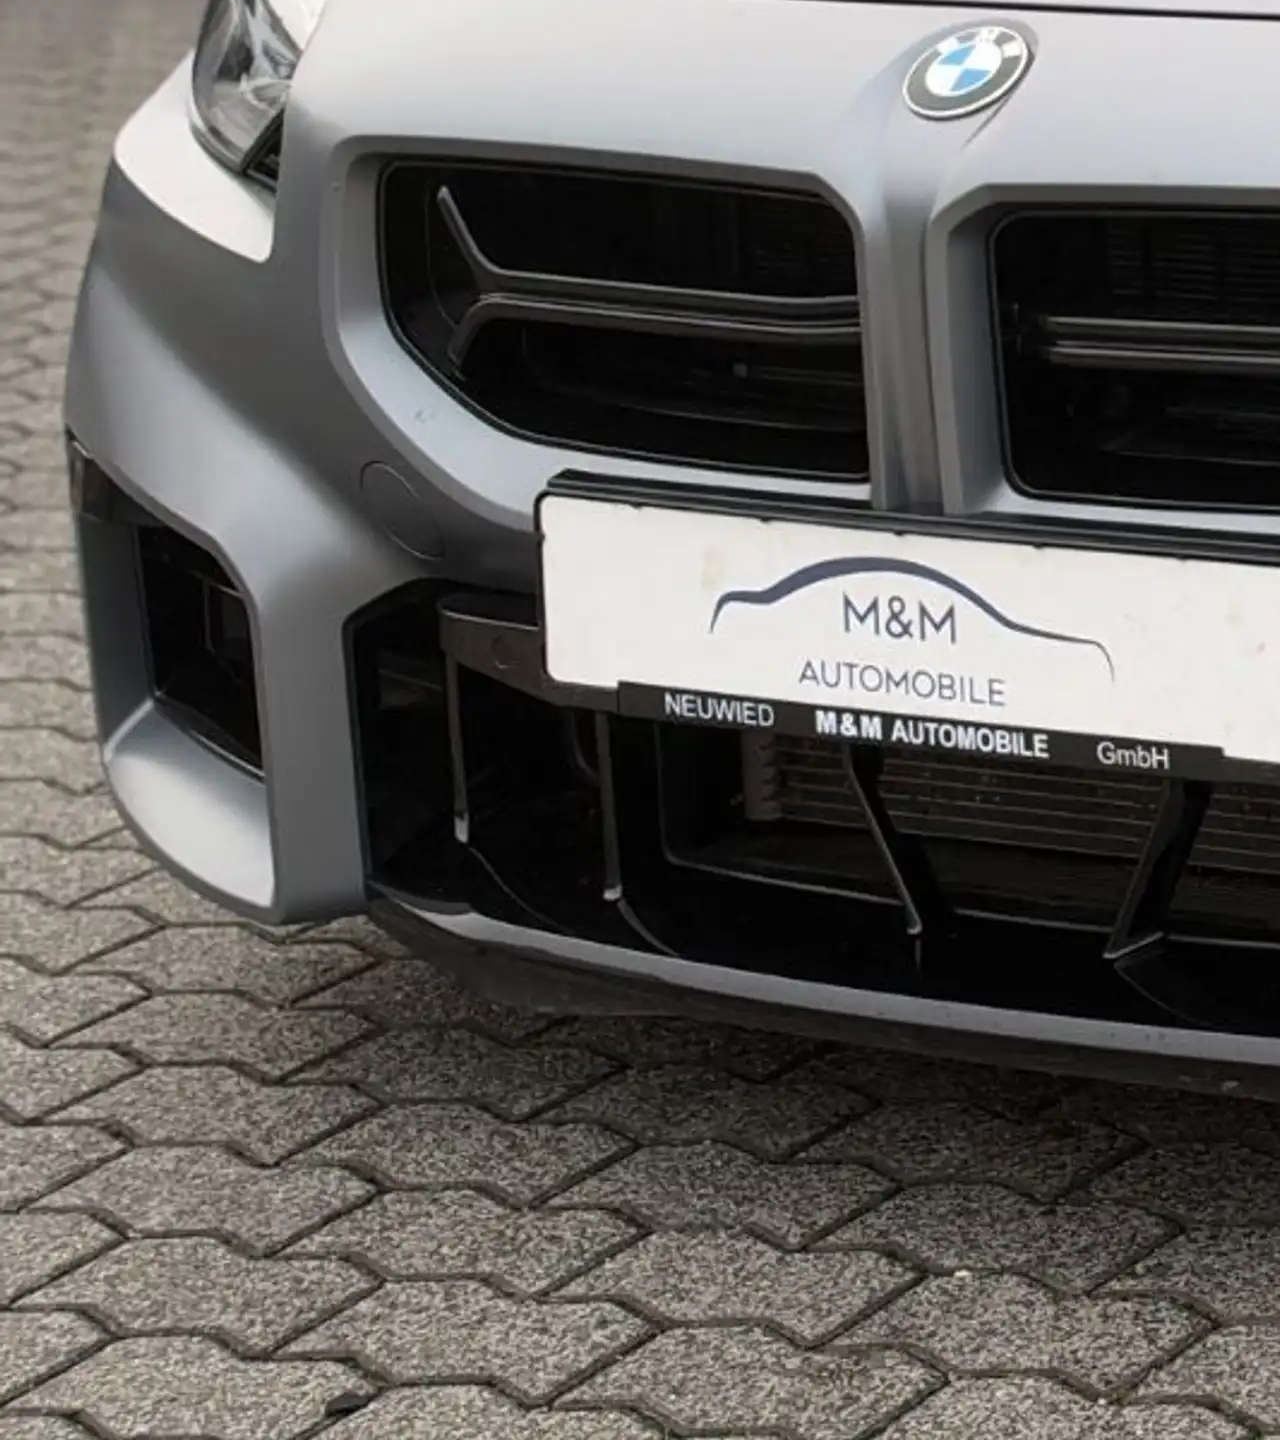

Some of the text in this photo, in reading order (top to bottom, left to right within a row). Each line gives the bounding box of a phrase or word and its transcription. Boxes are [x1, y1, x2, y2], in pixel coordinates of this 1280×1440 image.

[842, 590, 957, 645] M&M
[798, 659, 1006, 707] AUTOMOBILE
[664, 692, 775, 728] NEUWIED
[890, 724, 1050, 759] AUTOMOBILE
[1096, 742, 1170, 770] GmbH
